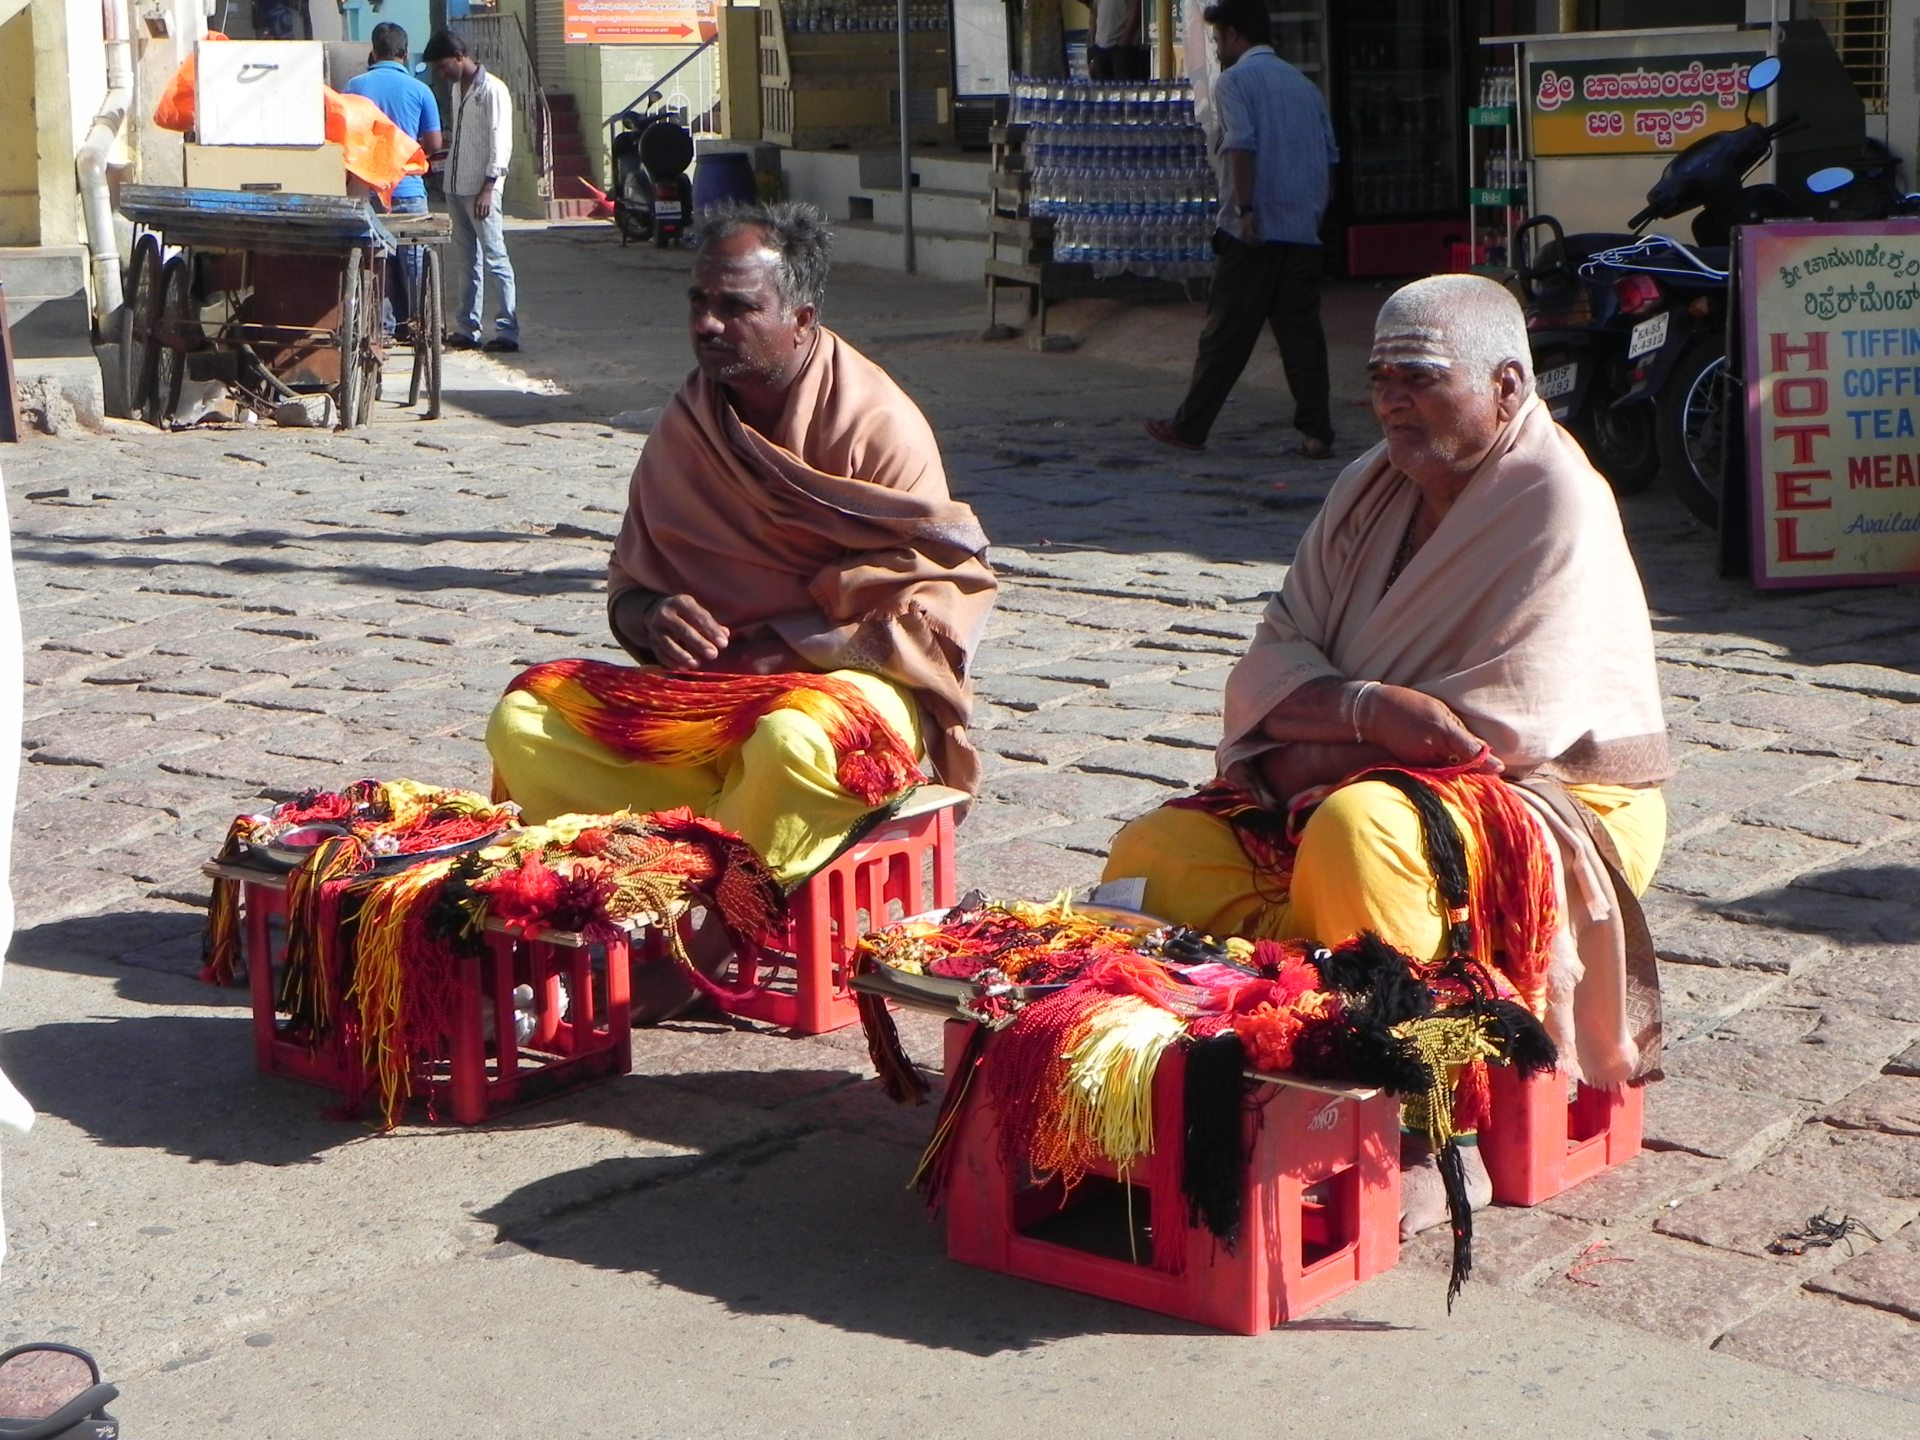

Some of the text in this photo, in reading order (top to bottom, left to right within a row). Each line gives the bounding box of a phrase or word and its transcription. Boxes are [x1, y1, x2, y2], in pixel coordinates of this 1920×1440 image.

[1537, 71, 1574, 110] ಶ್ರೀ
[1846, 408, 1915, 440] TEA
[1769, 331, 1836, 563] HOTEL
[1847, 454, 1920, 490] MEA
